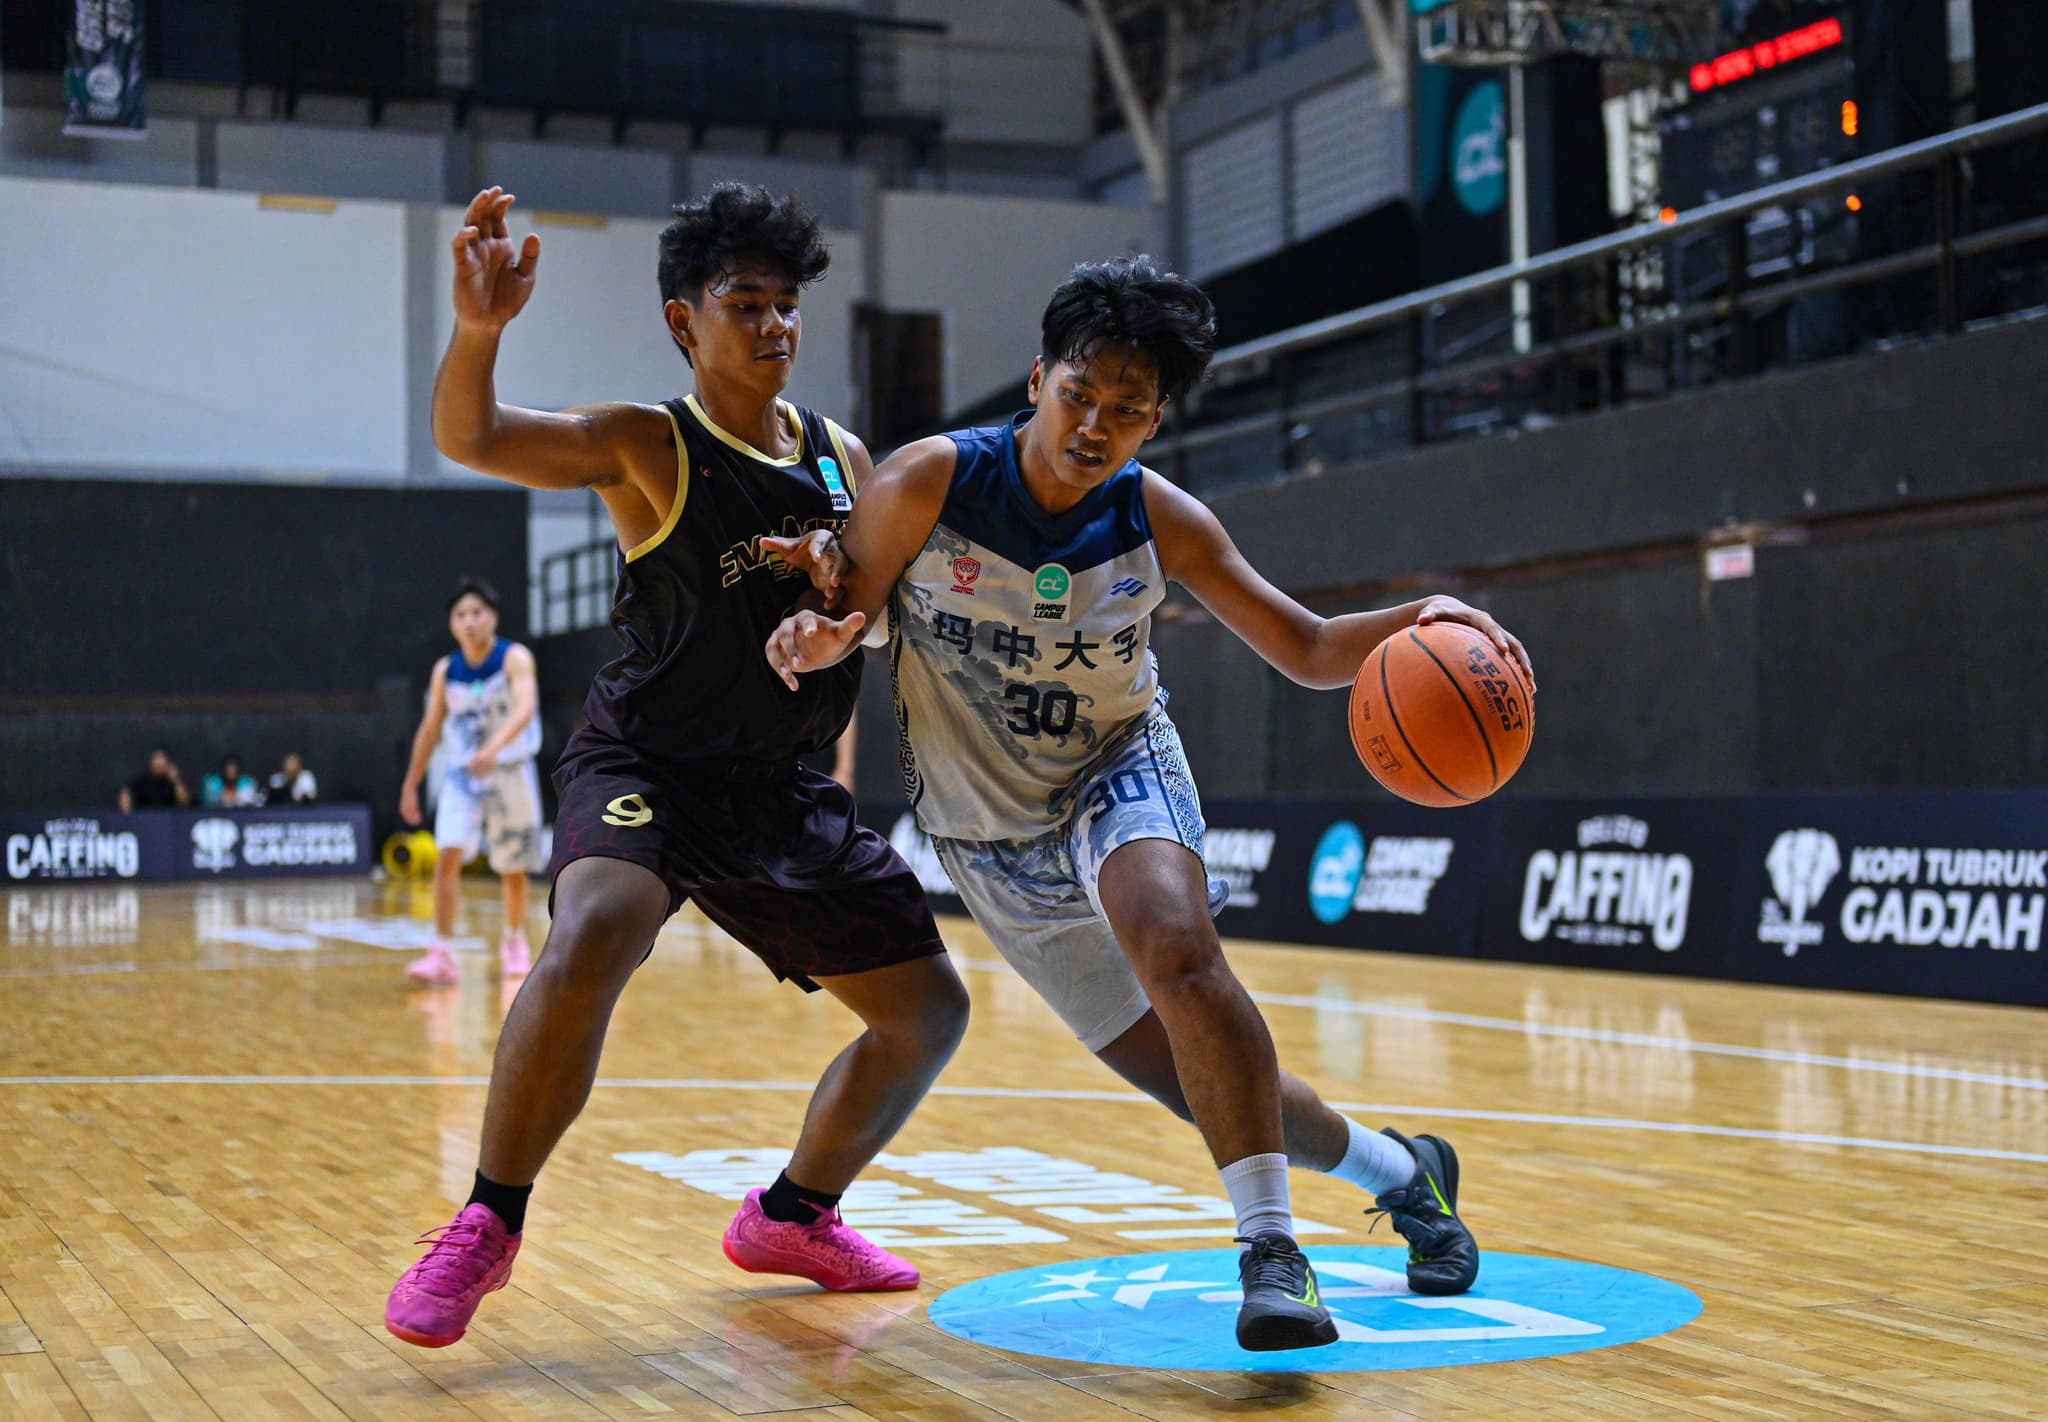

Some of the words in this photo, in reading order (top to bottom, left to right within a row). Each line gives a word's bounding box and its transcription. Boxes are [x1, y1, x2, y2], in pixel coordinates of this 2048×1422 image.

[1033, 611, 1065, 620] LEAGUE
[1034, 602, 1067, 613] CAMPUS
[1004, 683, 1078, 737] 30
[1468, 646, 1524, 731] REACT
[601, 794, 653, 828] 9
[1084, 769, 1150, 823] 30
[1850, 846, 1920, 884] KOPI
[1924, 848, 2048, 888] TUBRUK
[1519, 848, 1693, 952] CAFFINO
[1841, 886, 2045, 952] GADJAH
